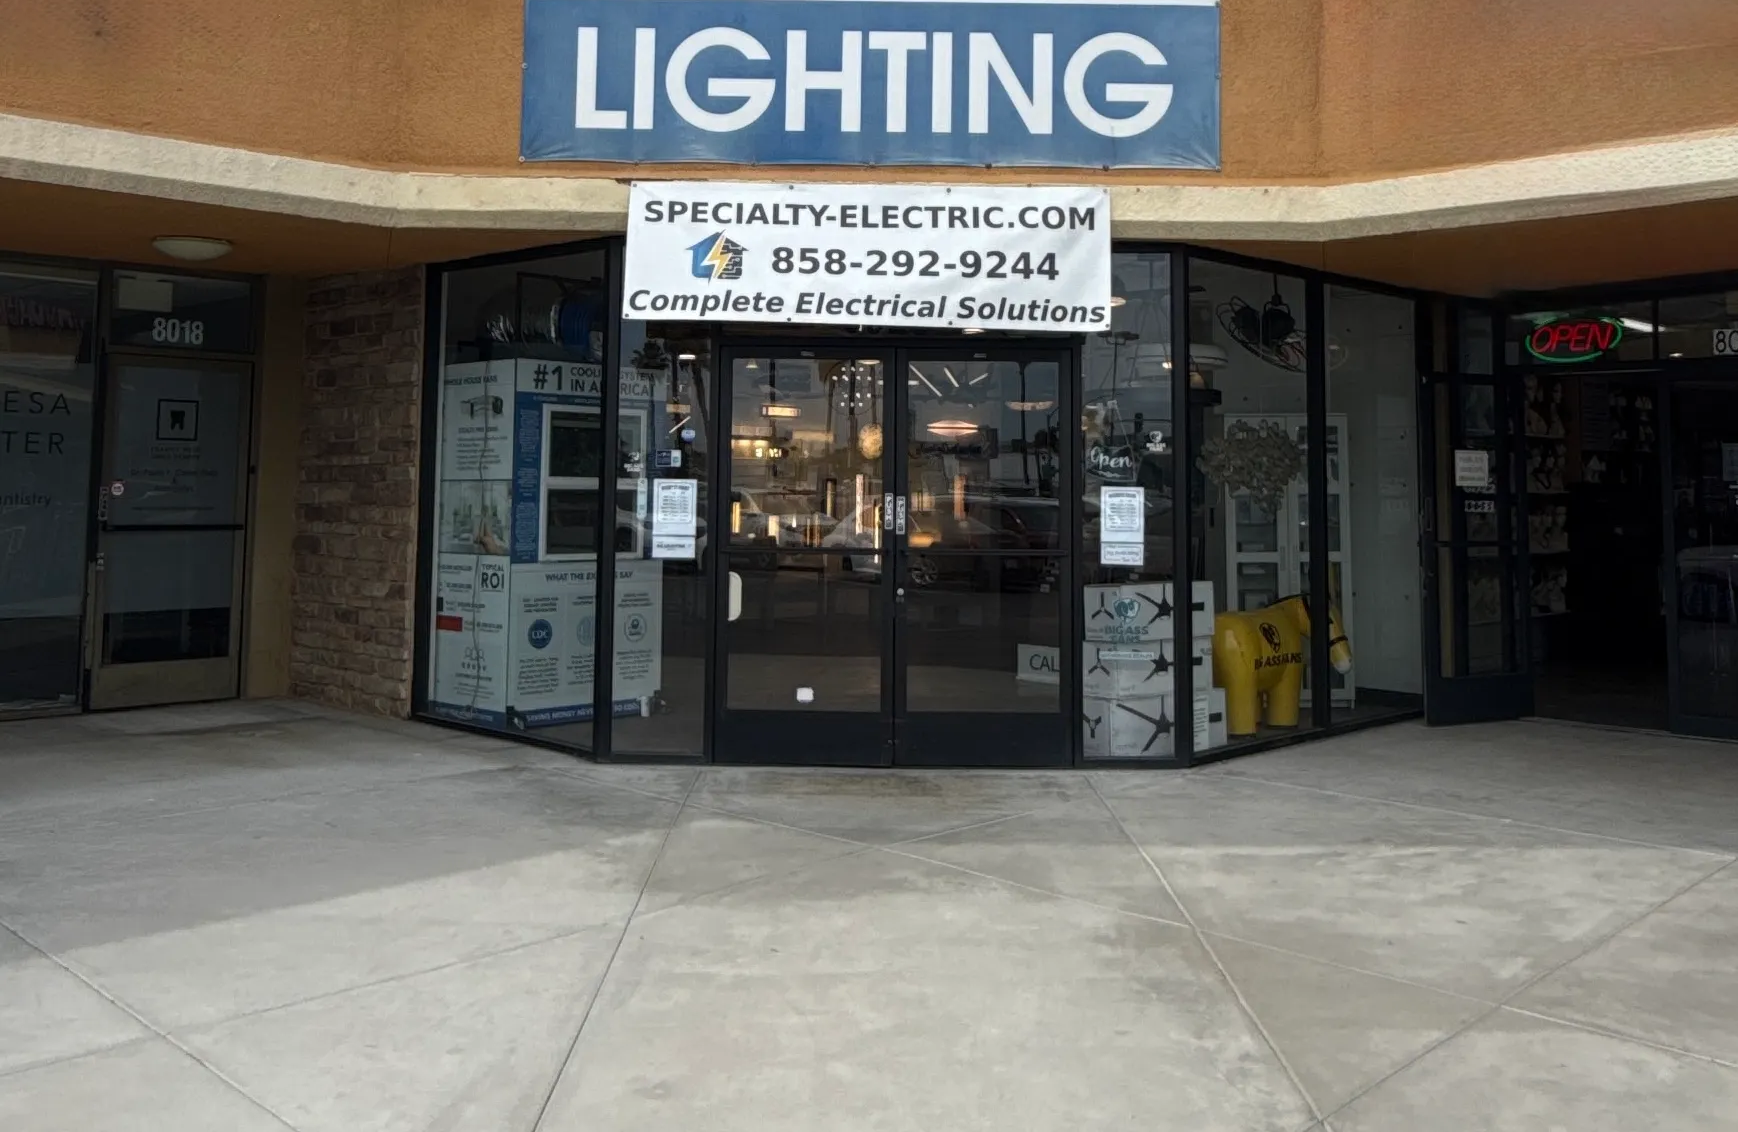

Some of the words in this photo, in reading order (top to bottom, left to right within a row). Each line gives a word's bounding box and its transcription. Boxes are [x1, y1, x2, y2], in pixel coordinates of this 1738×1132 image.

[574, 26, 1175, 139] LIGHTING
[644, 200, 1096, 231] SPECIALTY-ELECTRIC.COM
[771, 246, 1060, 281] 858-292-9244
[629, 289, 785, 317] Complete
[799, 291, 945, 319] Electrical
[956, 295, 1107, 324] Solutions
[152, 317, 205, 345] 8018
[1531, 321, 1615, 354] OPEN
[533, 364, 563, 391] #1
[570, 366, 601, 378] COOLI
[570, 378, 585, 392] IN
[1090, 445, 1133, 470] Open
[0, 491, 52, 510] ntistry
[481, 572, 505, 589] ROI
